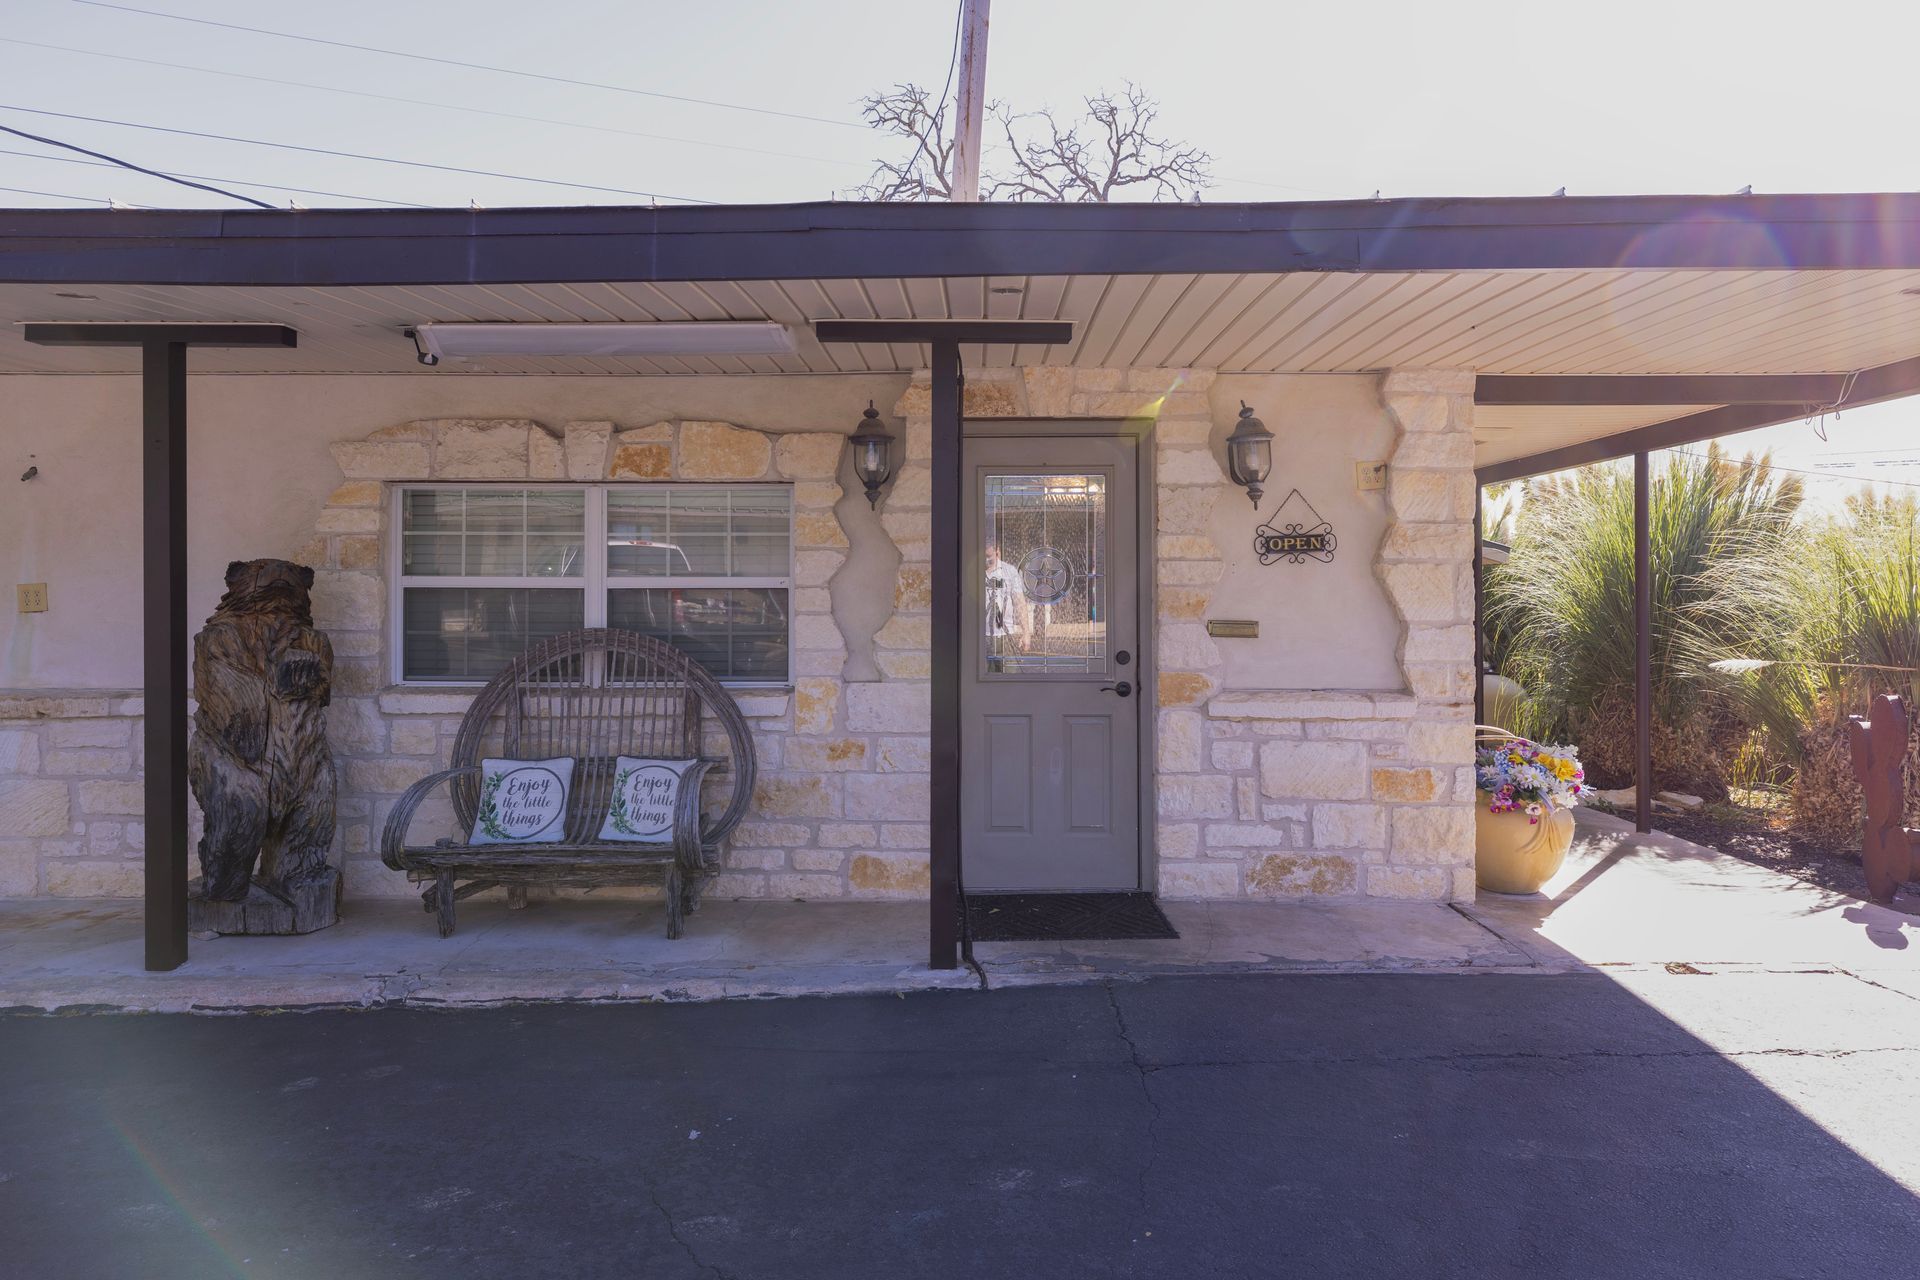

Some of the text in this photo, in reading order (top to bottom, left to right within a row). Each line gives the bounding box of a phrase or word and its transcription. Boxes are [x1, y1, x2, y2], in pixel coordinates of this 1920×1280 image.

[1269, 537, 1321, 550] OPEN
[507, 777, 552, 800] Enjoy
[634, 774, 673, 796] Enjoy
[503, 796, 552, 809] the little
[631, 793, 674, 806] the little
[502, 810, 544, 828] things
[631, 806, 667, 825] things
